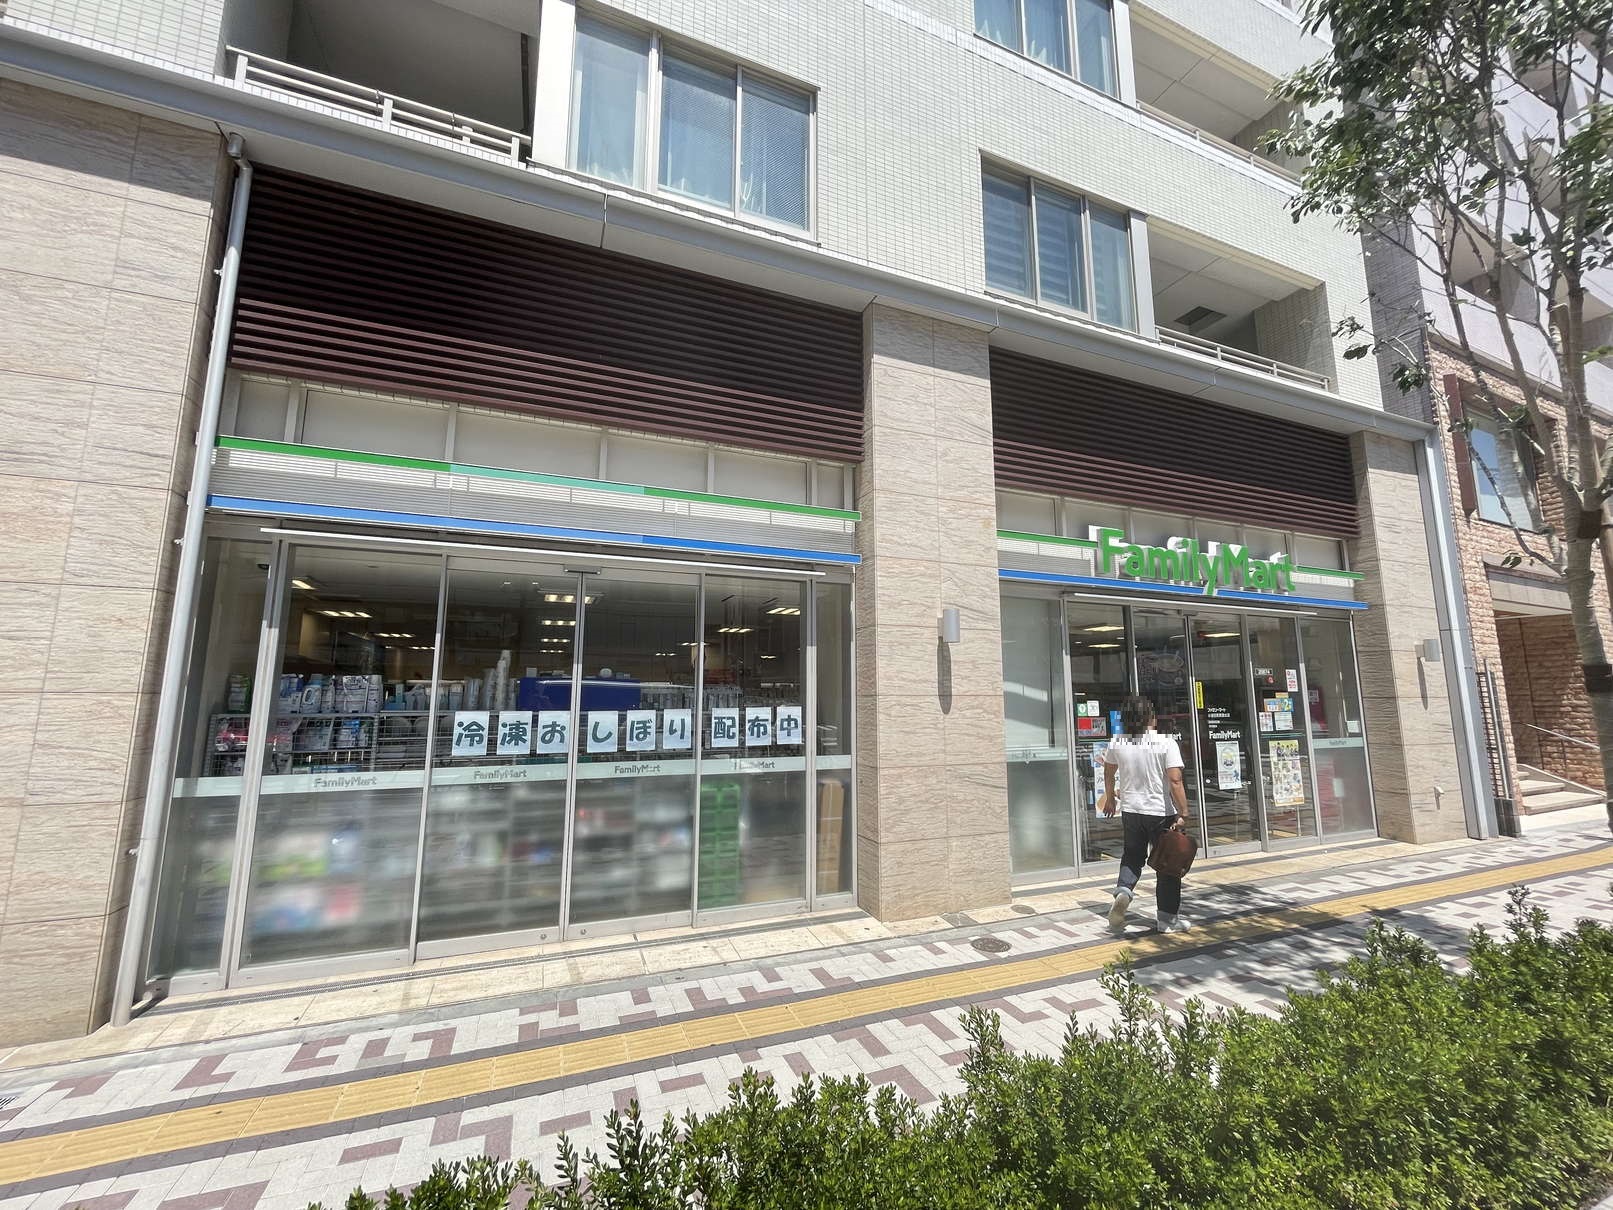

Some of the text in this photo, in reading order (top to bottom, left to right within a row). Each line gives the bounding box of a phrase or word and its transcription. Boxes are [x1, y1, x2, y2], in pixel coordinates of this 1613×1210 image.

[1096, 527, 1297, 596] FamilyMart
[454, 713, 801, 748] 冷凍おしぼり配布中
[1208, 730, 1241, 740] FamilyMart
[473, 769, 528, 780] FamilyMart
[313, 776, 378, 788] FamilyMart
